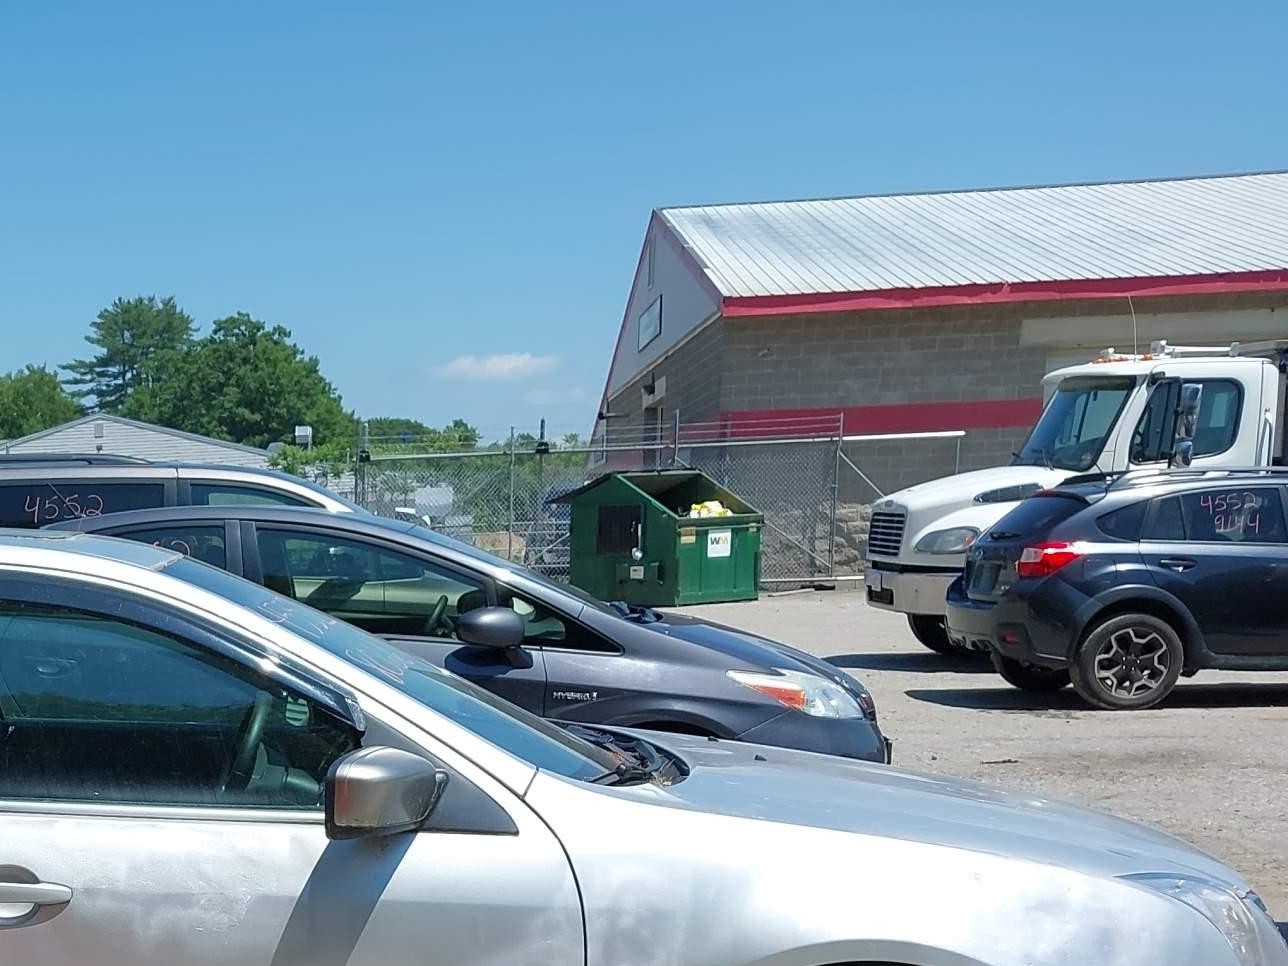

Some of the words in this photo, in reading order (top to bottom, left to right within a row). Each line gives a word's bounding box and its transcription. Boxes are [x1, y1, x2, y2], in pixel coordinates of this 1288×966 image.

[24, 494, 105, 524] 4552
[1200, 492, 1258, 515] 4552
[1214, 513, 1259, 534] 9144
[710, 536, 729, 545] WM
